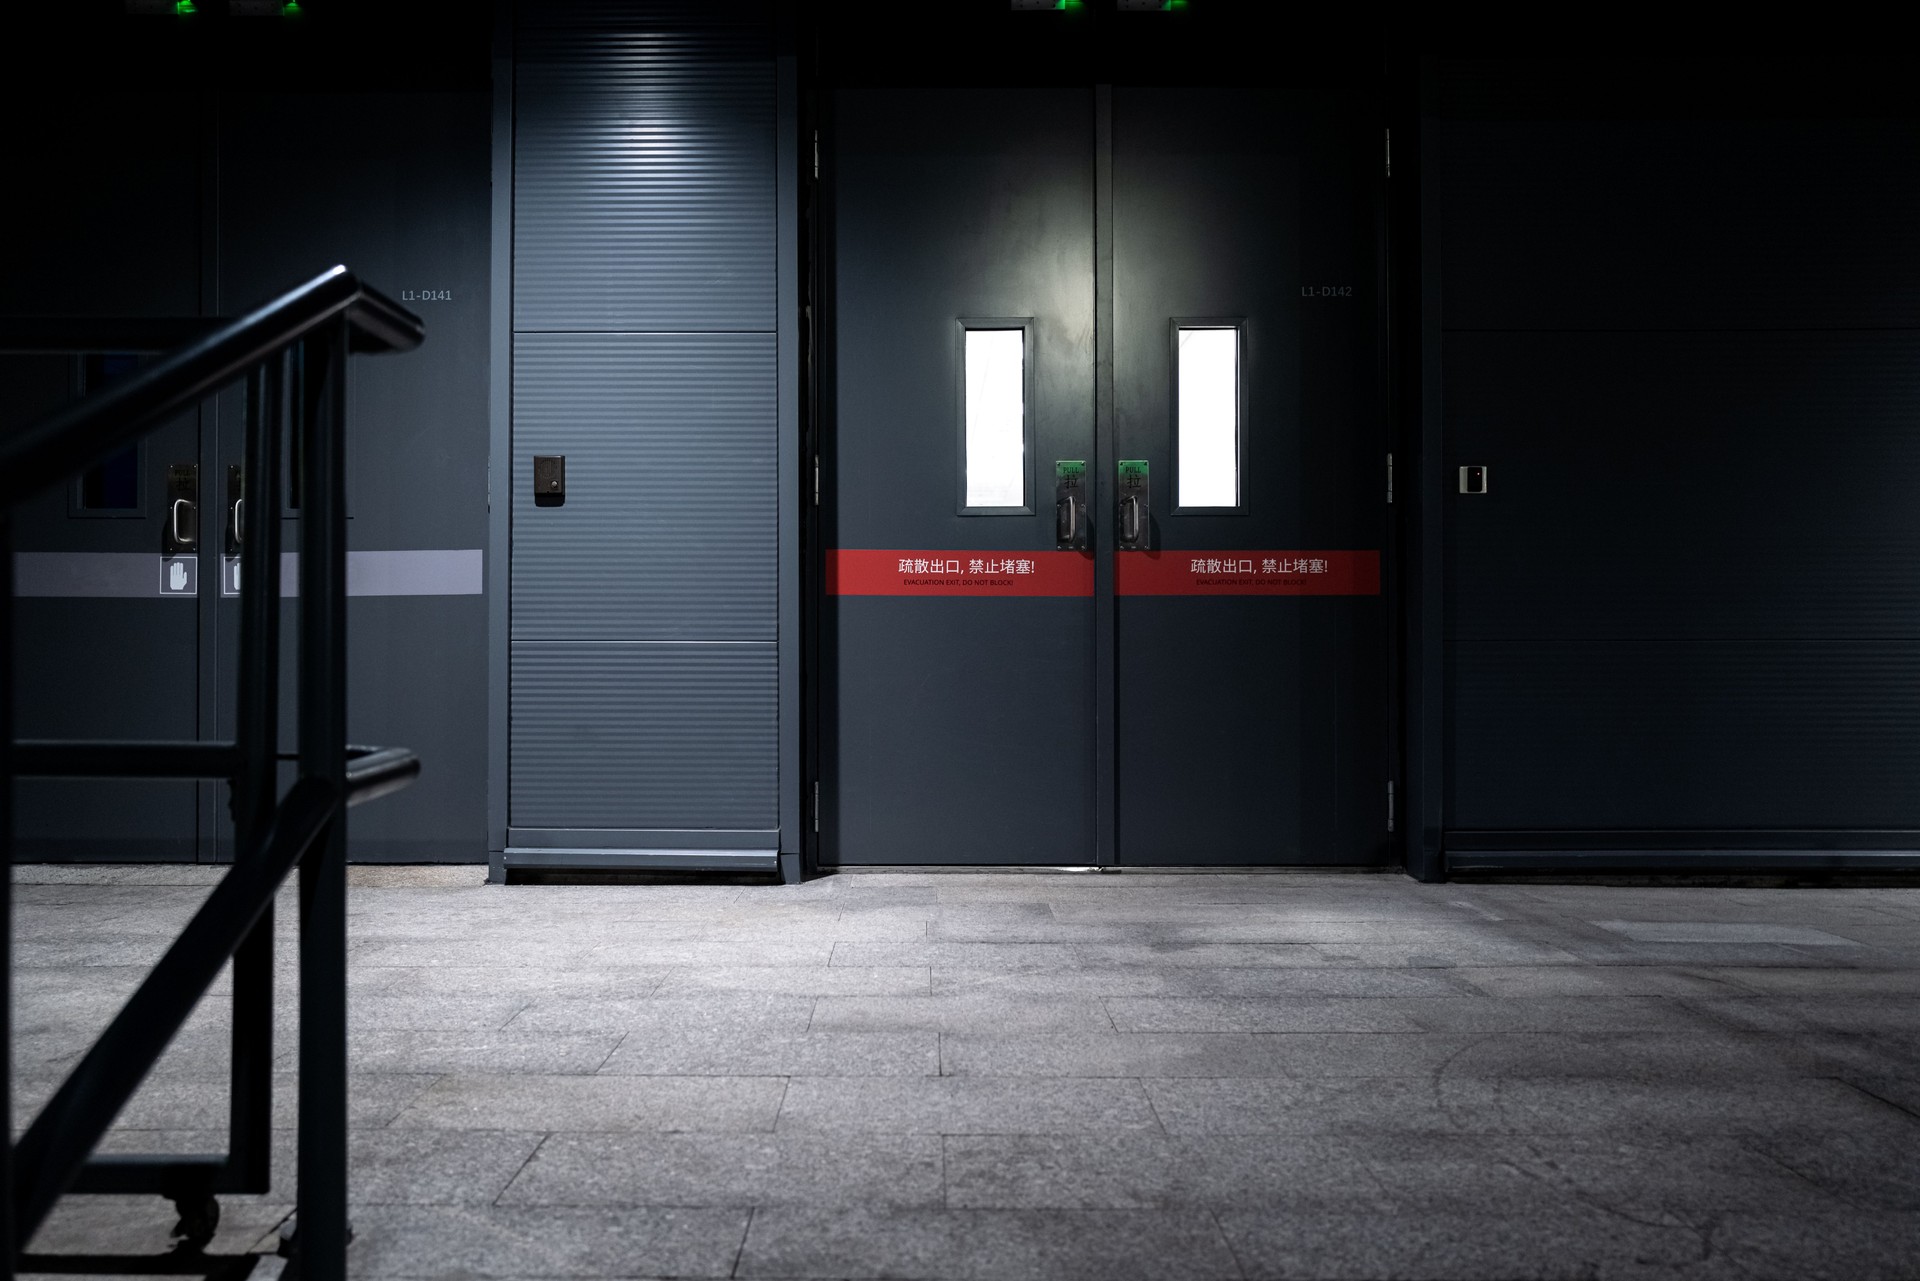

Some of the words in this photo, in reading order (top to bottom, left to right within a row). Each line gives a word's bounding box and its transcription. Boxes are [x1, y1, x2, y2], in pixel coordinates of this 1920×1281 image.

[402, 290, 452, 301] L1-D141
[1301, 286, 1353, 297] L1-D142
[1064, 475, 1078, 489] 拉
[1127, 475, 1141, 489] 拉
[946, 579, 961, 587] EXIT,
